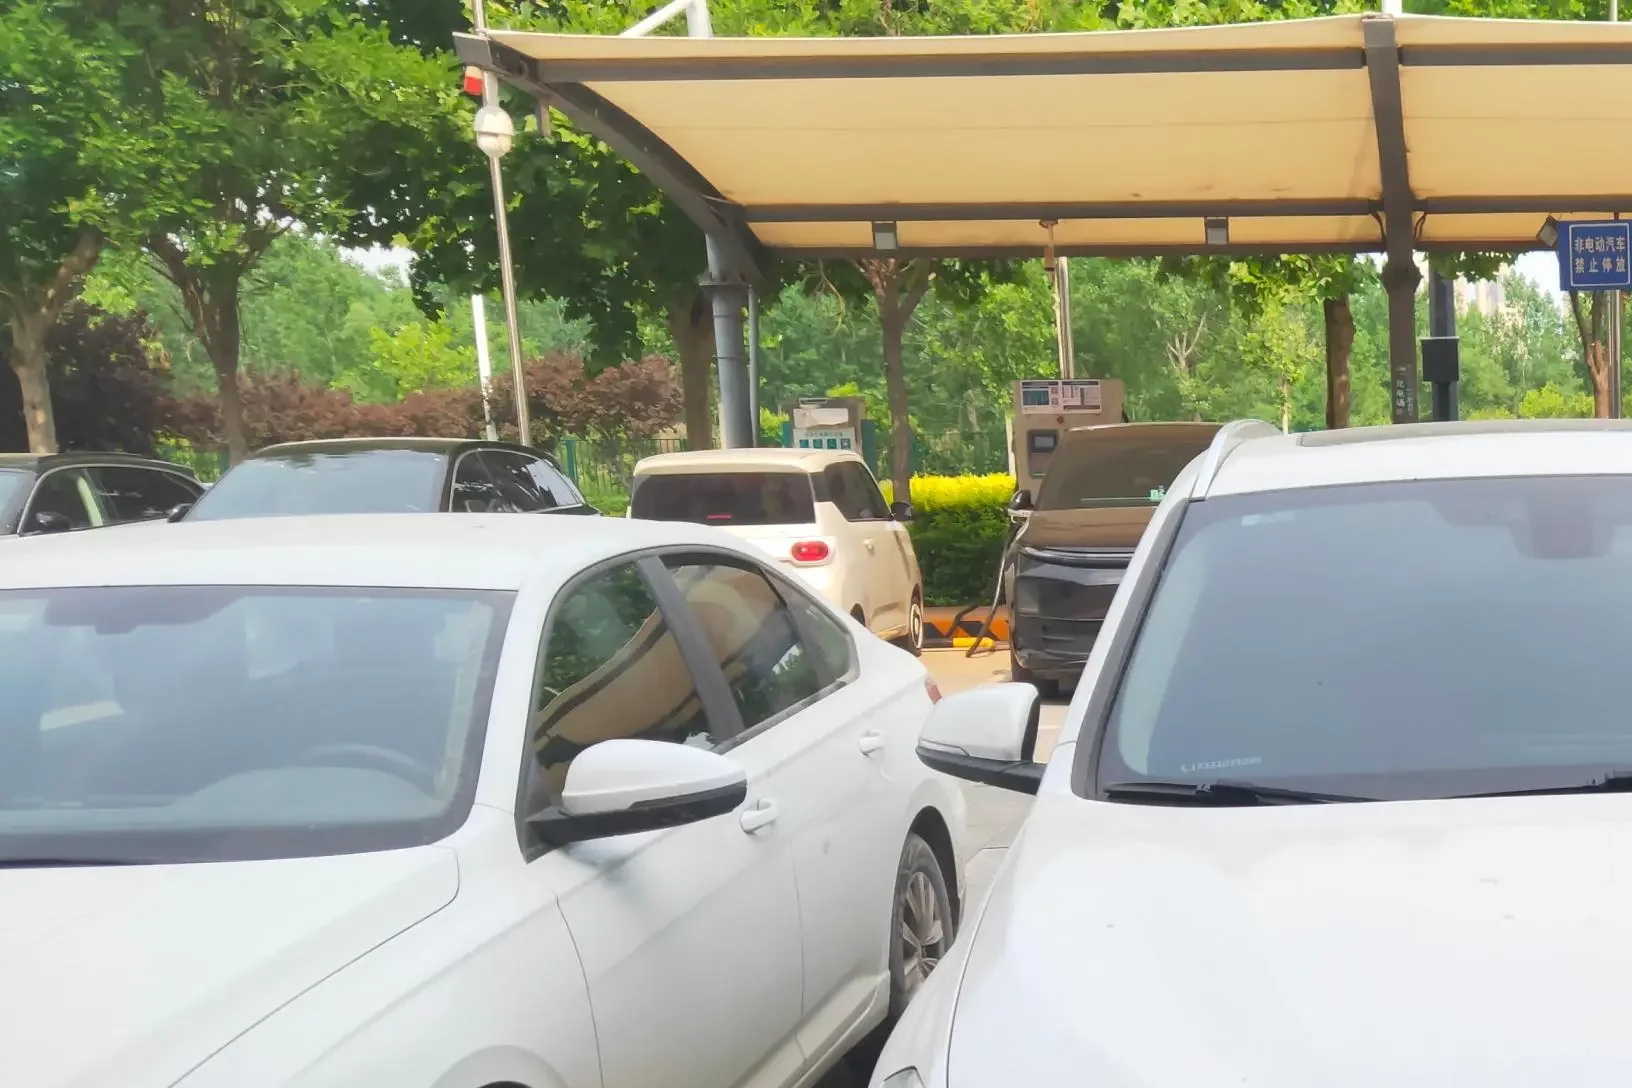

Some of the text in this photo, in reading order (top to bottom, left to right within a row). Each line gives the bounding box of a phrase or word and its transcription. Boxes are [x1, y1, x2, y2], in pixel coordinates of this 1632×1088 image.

[1574, 236, 1626, 254] 非电动汽车
[1574, 256, 1626, 274] 禁止停放
